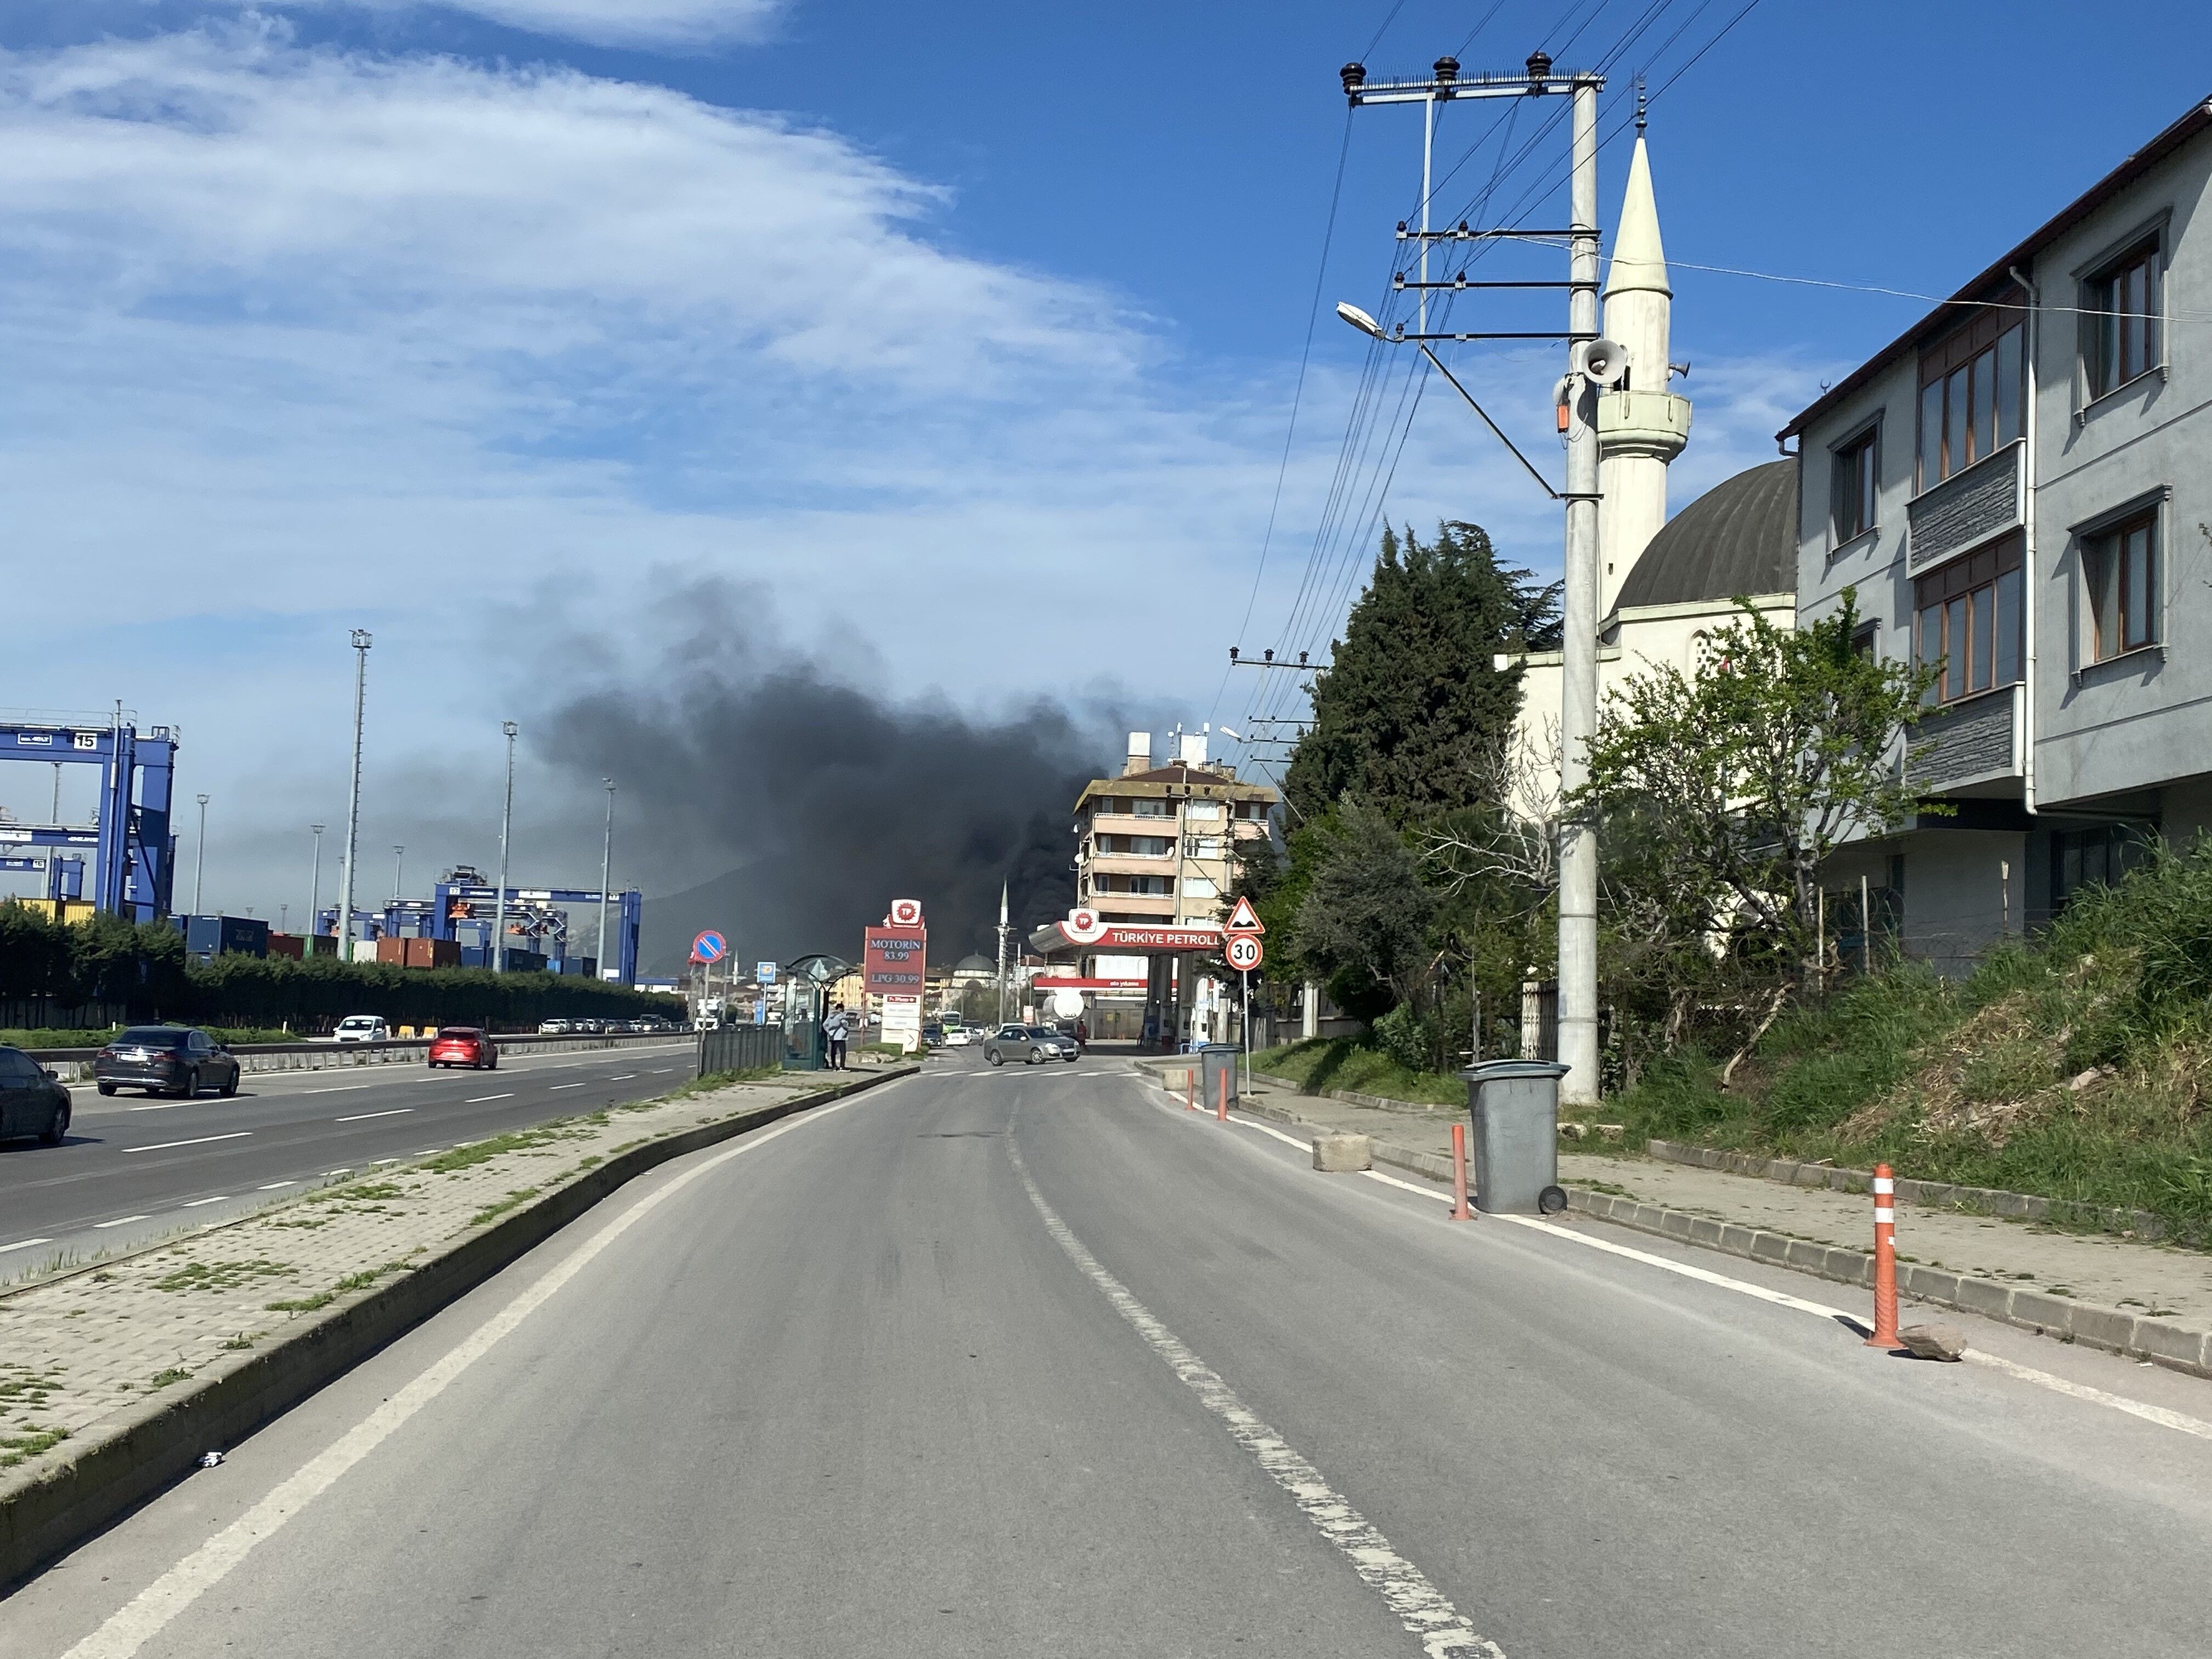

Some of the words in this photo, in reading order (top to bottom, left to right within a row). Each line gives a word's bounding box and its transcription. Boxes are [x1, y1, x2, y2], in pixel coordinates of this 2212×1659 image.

[77, 735, 94, 747] 15
[901, 908, 912, 916] TP
[1112, 930, 1164, 944] TÜRKİYE
[870, 939, 921, 949] MOTORİN
[884, 951, 910, 960] 83.99
[1234, 944, 1255, 960] 30
[871, 974, 892, 983] LPG
[894, 974, 920, 984] 30.99
